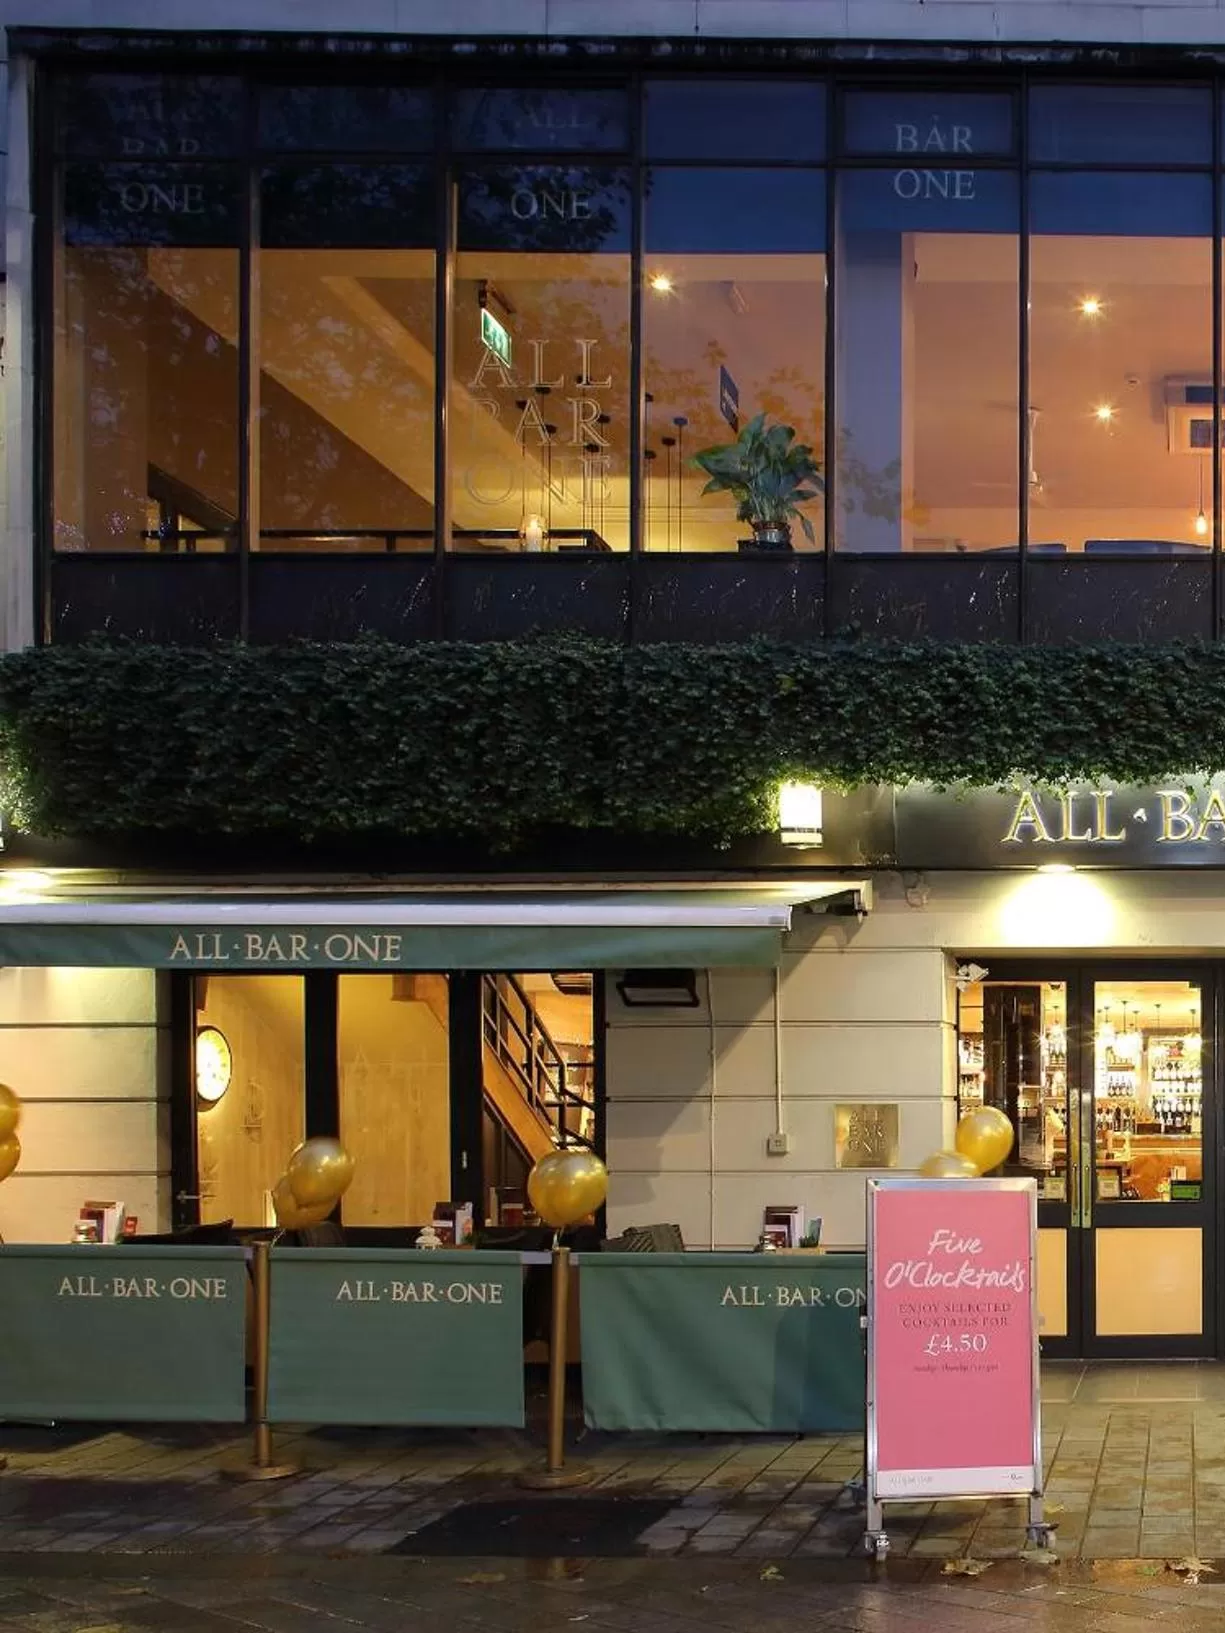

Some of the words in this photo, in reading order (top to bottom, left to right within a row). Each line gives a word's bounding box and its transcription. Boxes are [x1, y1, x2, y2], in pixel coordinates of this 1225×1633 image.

[894, 123, 974, 154] BAR
[119, 181, 206, 214] ONE
[894, 168, 976, 199] ONE
[510, 188, 593, 220] ONE
[468, 338, 613, 389] ALL
[465, 454, 613, 506] ONE
[1000, 790, 1127, 843] ALL
[168, 934, 230, 961] ALL
[244, 934, 310, 961] BAR
[324, 933, 402, 962] ONE
[927, 1229, 984, 1255] Five
[57, 1276, 102, 1297] ALL
[112, 1277, 162, 1298] BAR
[170, 1277, 227, 1299] ONE
[336, 1280, 381, 1301] ALL
[390, 1281, 439, 1302] BAR
[447, 1282, 503, 1304] ONE
[720, 1285, 766, 1306] ALL
[775, 1286, 825, 1307] BAR
[834, 1287, 867, 1308] ON
[899, 1303, 939, 1315] ENJOY
[943, 1303, 1012, 1314] SELECTED
[902, 1317, 979, 1329] COCKTAILS
[982, 1316, 1008, 1327] FOR
[923, 1333, 988, 1357] £4.50
